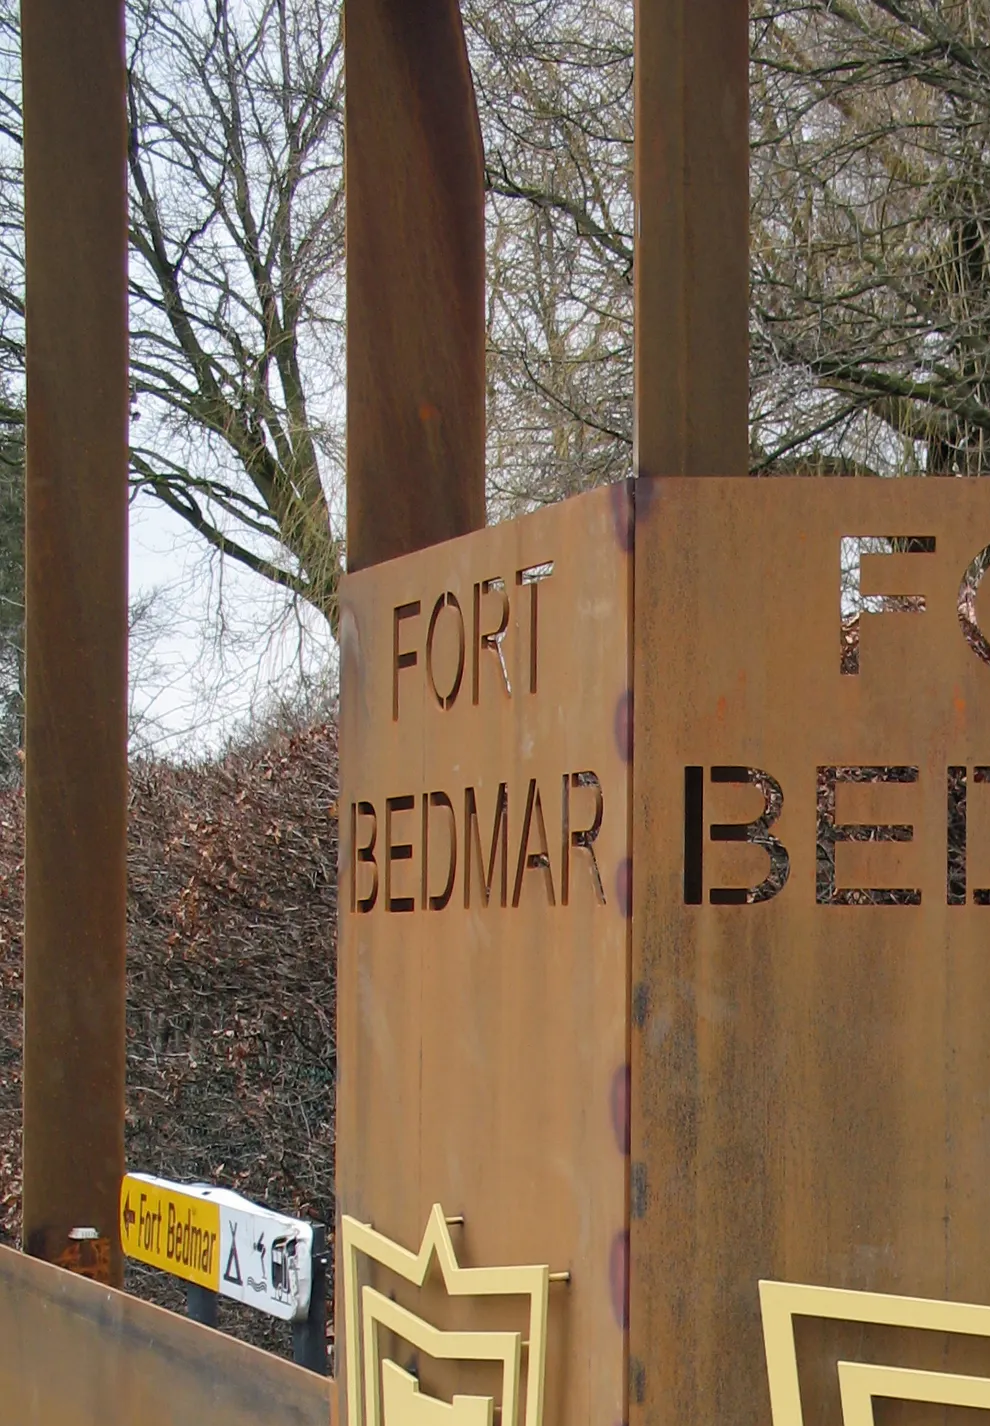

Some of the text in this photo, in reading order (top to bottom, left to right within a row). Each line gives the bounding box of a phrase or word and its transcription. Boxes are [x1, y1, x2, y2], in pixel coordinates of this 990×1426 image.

[392, 560, 554, 721] FORT
[350, 770, 607, 913] BEDMAR
[138, 1193, 217, 1275] Fort Bedmar
